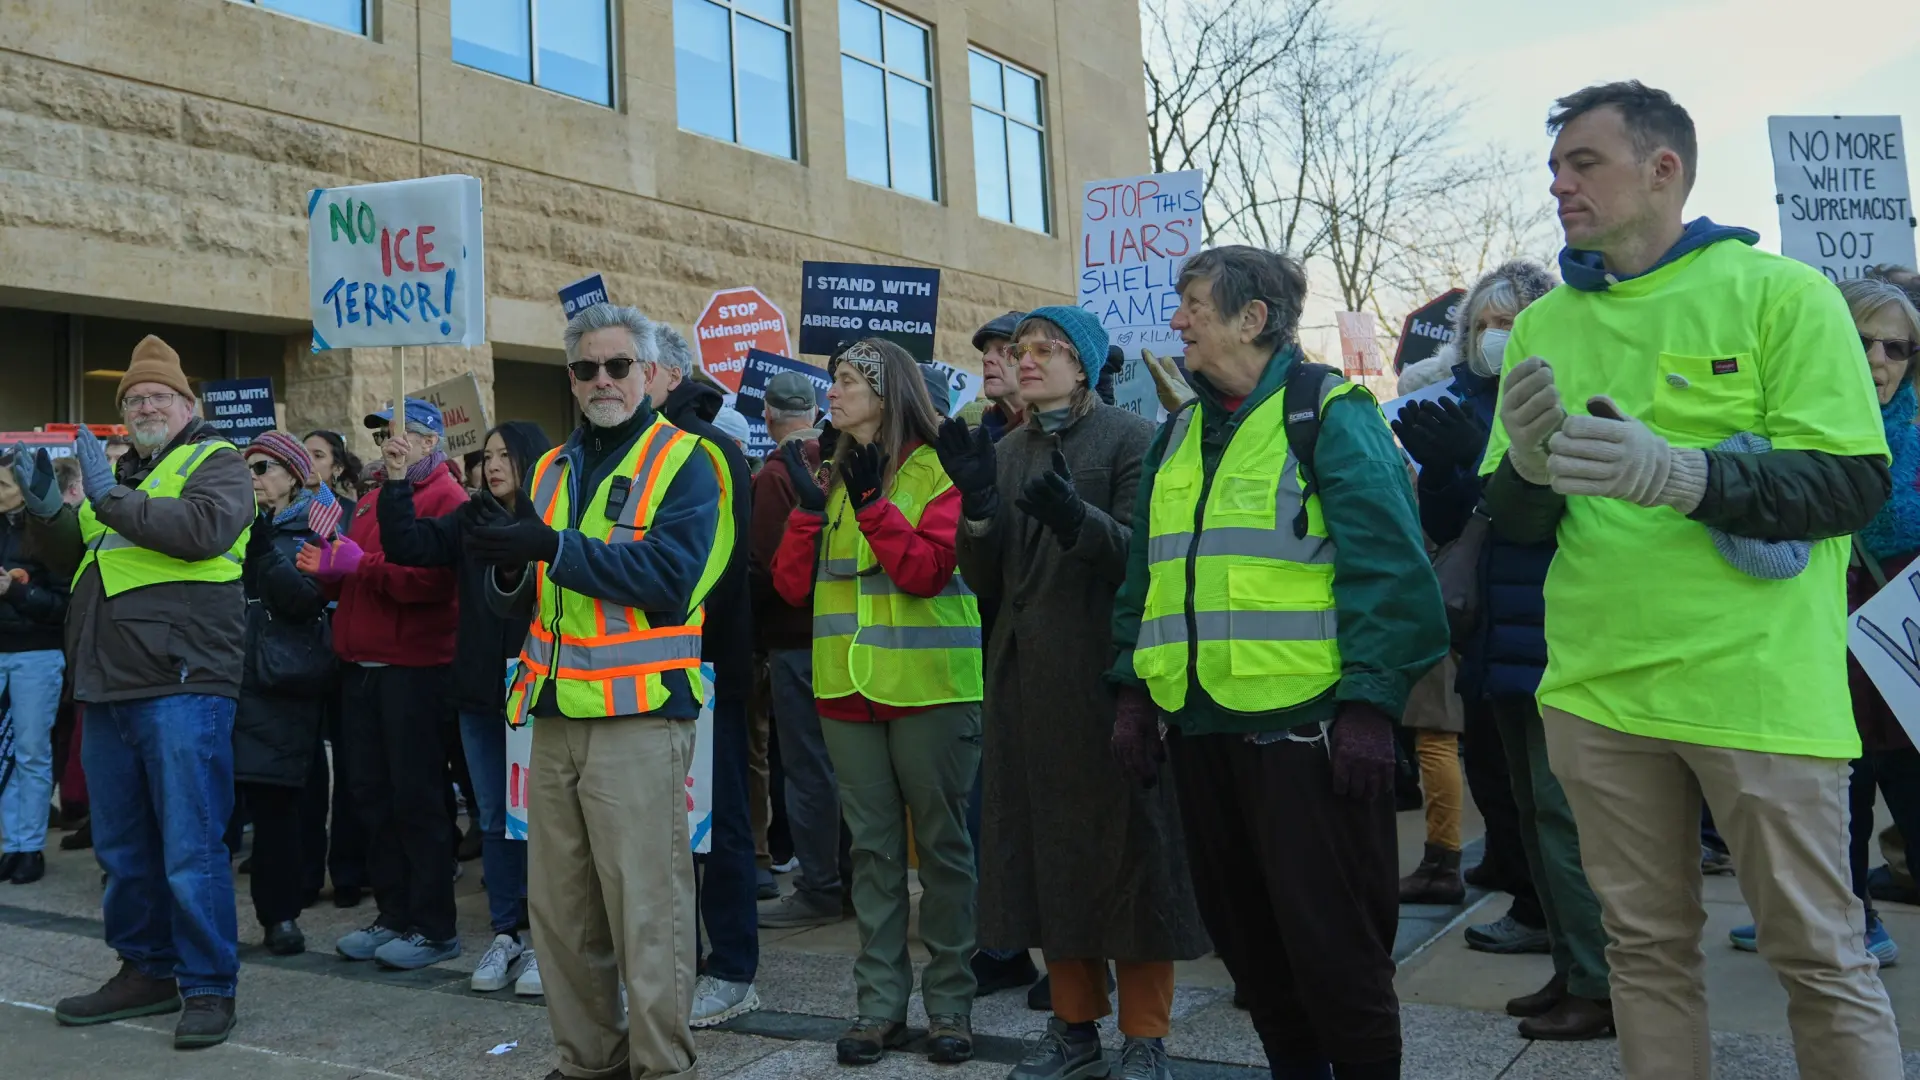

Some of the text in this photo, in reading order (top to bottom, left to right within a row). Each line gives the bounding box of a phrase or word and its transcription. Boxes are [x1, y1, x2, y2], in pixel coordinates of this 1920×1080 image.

[1789, 130, 1898, 161] NO MORE
[1802, 165, 1876, 192] WHITE
[1086, 180, 1201, 221] STOP THIS
[1791, 194, 1907, 221] SUPREMACIST
[329, 197, 376, 244] NO
[381, 225, 445, 277] ICE
[1816, 231, 1874, 259] DOJ
[807, 275, 931, 297] I STAND WITH
[1082, 259, 1177, 294] SHELL
[322, 267, 457, 336] TERROR!
[575, 287, 605, 309] WITH
[832, 296, 899, 313] KILMAR
[718, 302, 758, 319] STOP
[700, 318, 781, 340] kidnapping
[802, 314, 933, 335] ABREGO GARCIA
[1139, 330, 1182, 344] KILM
[748, 358, 755, 369] I
[206, 389, 237, 403] STAND
[239, 387, 269, 401] WITH
[215, 403, 253, 416] KILMAR
[235, 416, 276, 429] GARCIA
